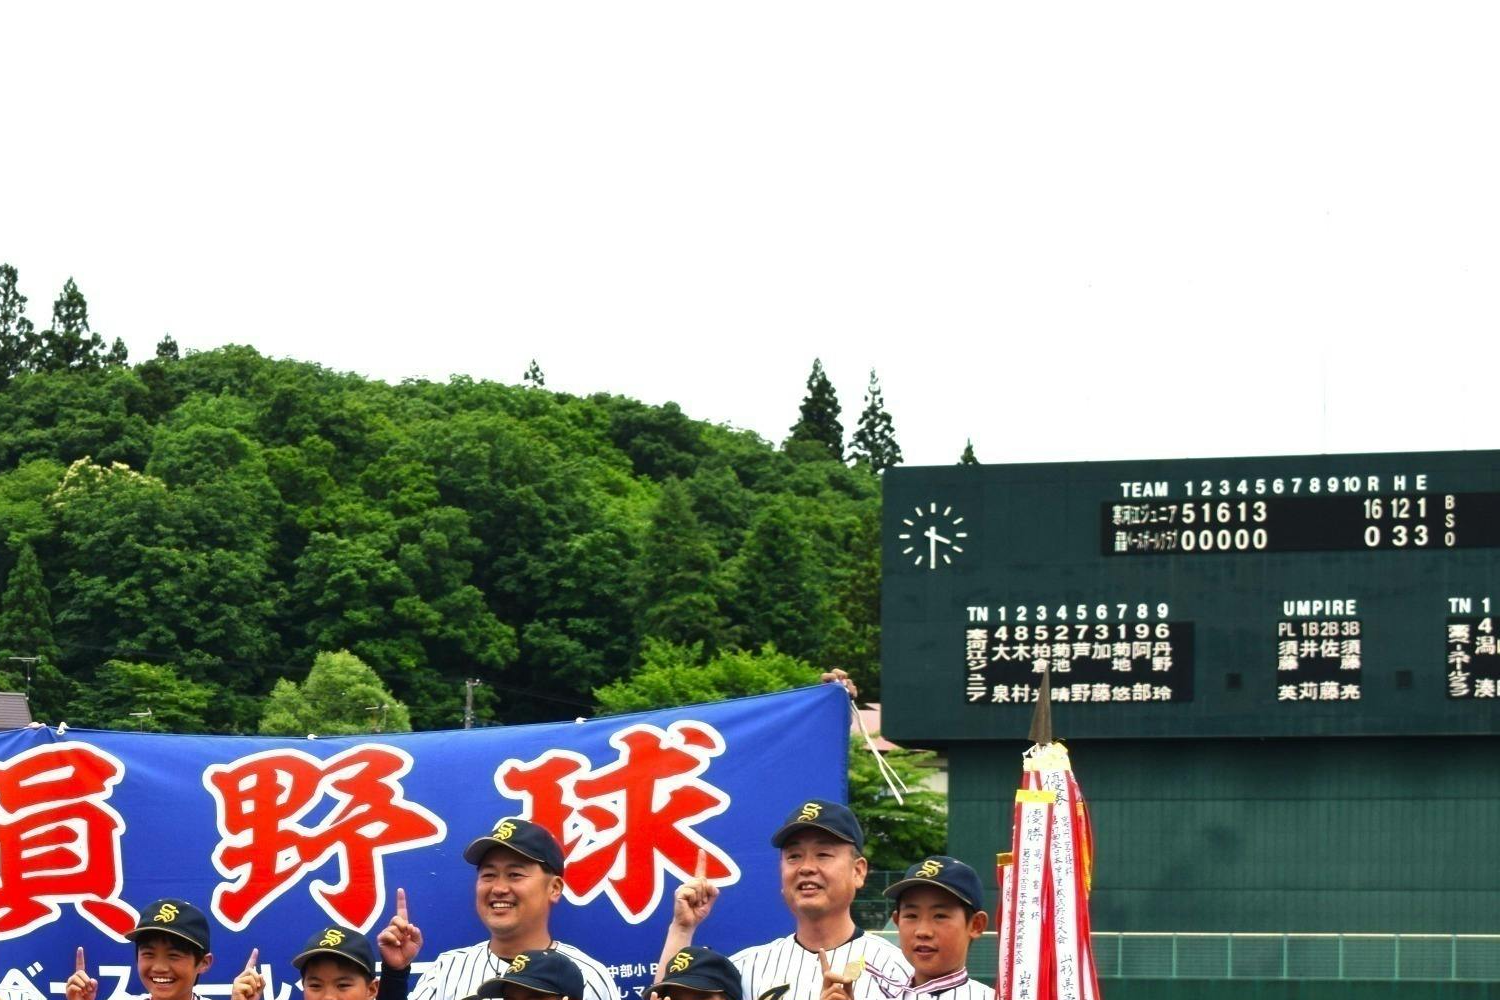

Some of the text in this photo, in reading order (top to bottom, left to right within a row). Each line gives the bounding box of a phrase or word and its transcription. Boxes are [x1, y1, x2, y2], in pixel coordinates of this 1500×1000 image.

[1120, 474, 1427, 498] TEAM 1 2 3 4 5 6 7 8 9 10 R H E
[967, 603, 1169, 621] TN 1 2 3 4 5 6 7 8 9
[1283, 599, 1357, 616] UMPIRE
[1448, 597, 1490, 614] TN 1
[1278, 621, 1360, 637] PL 1B 2B 3B
